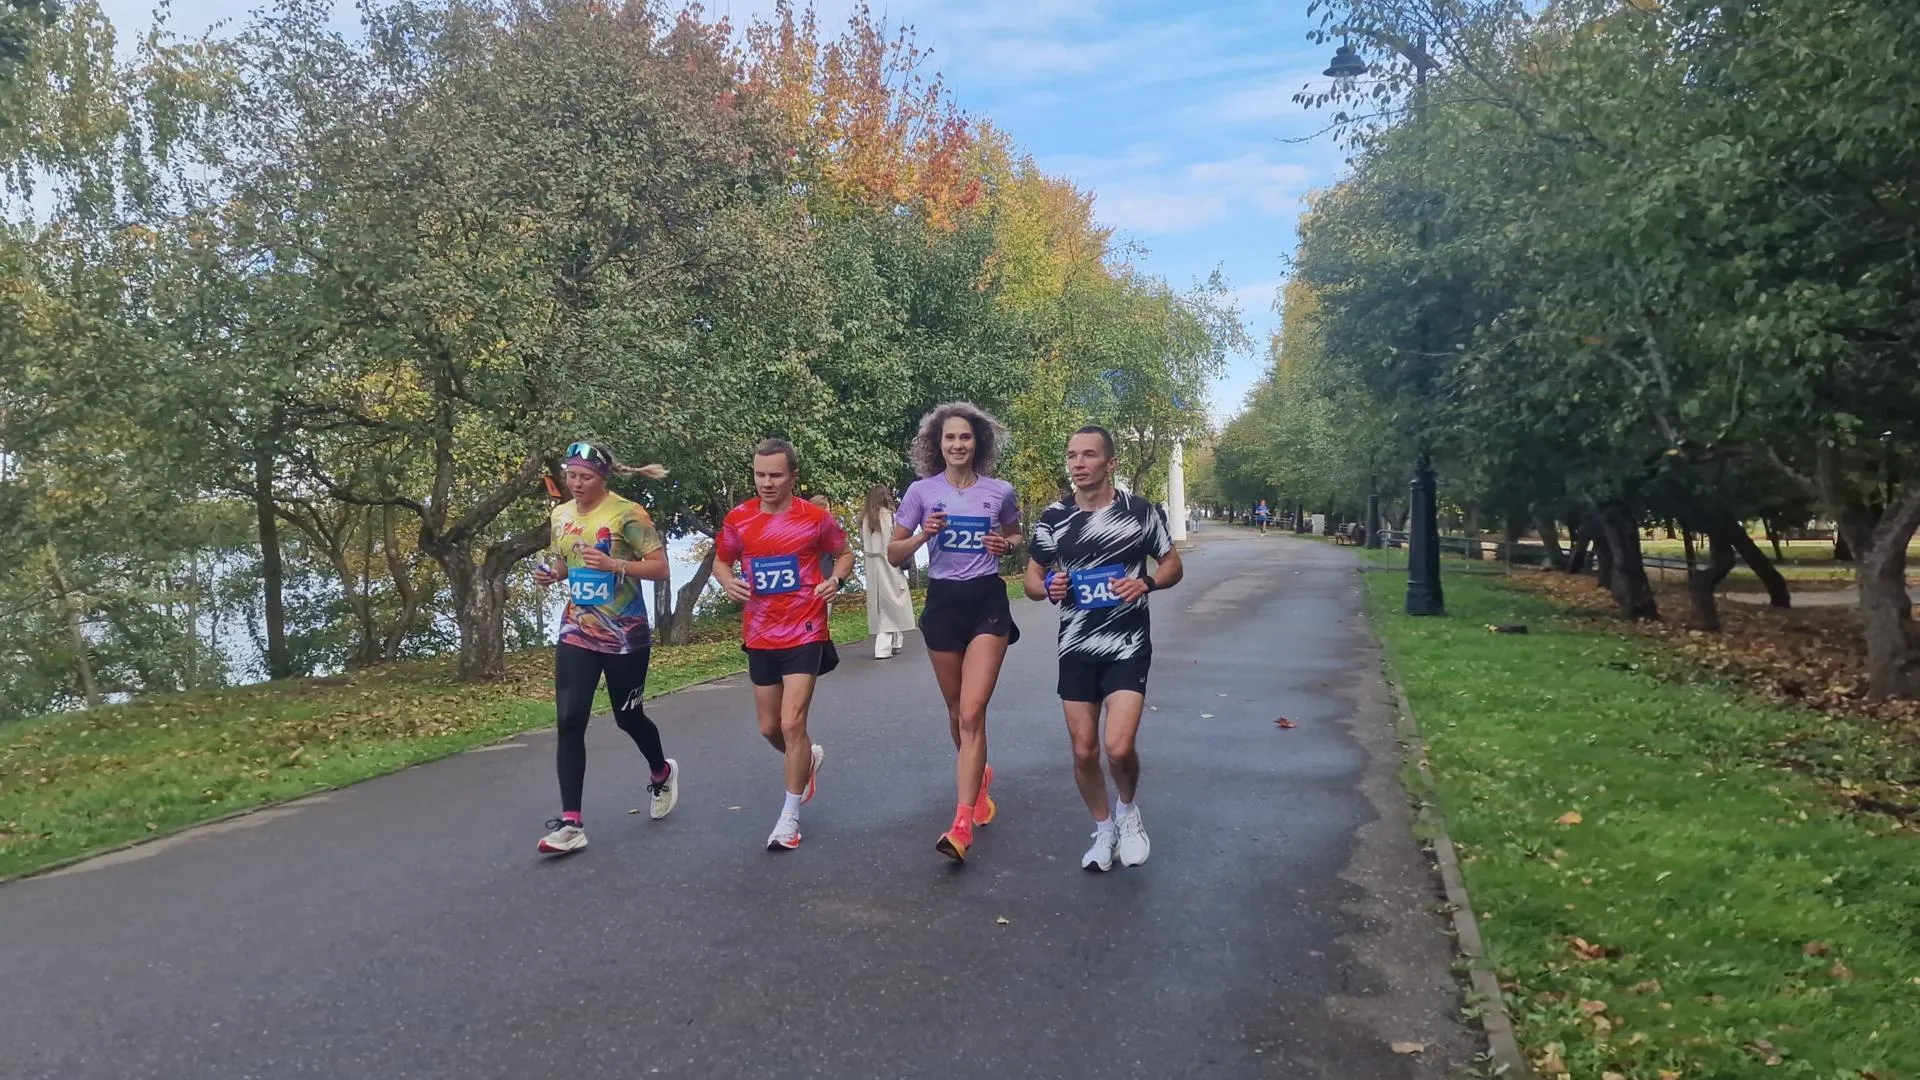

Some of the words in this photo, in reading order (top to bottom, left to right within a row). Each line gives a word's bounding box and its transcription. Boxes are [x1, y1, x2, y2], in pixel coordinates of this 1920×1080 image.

[944, 530, 986, 549] 225
[755, 569, 795, 590] 373
[571, 582, 610, 600] 454
